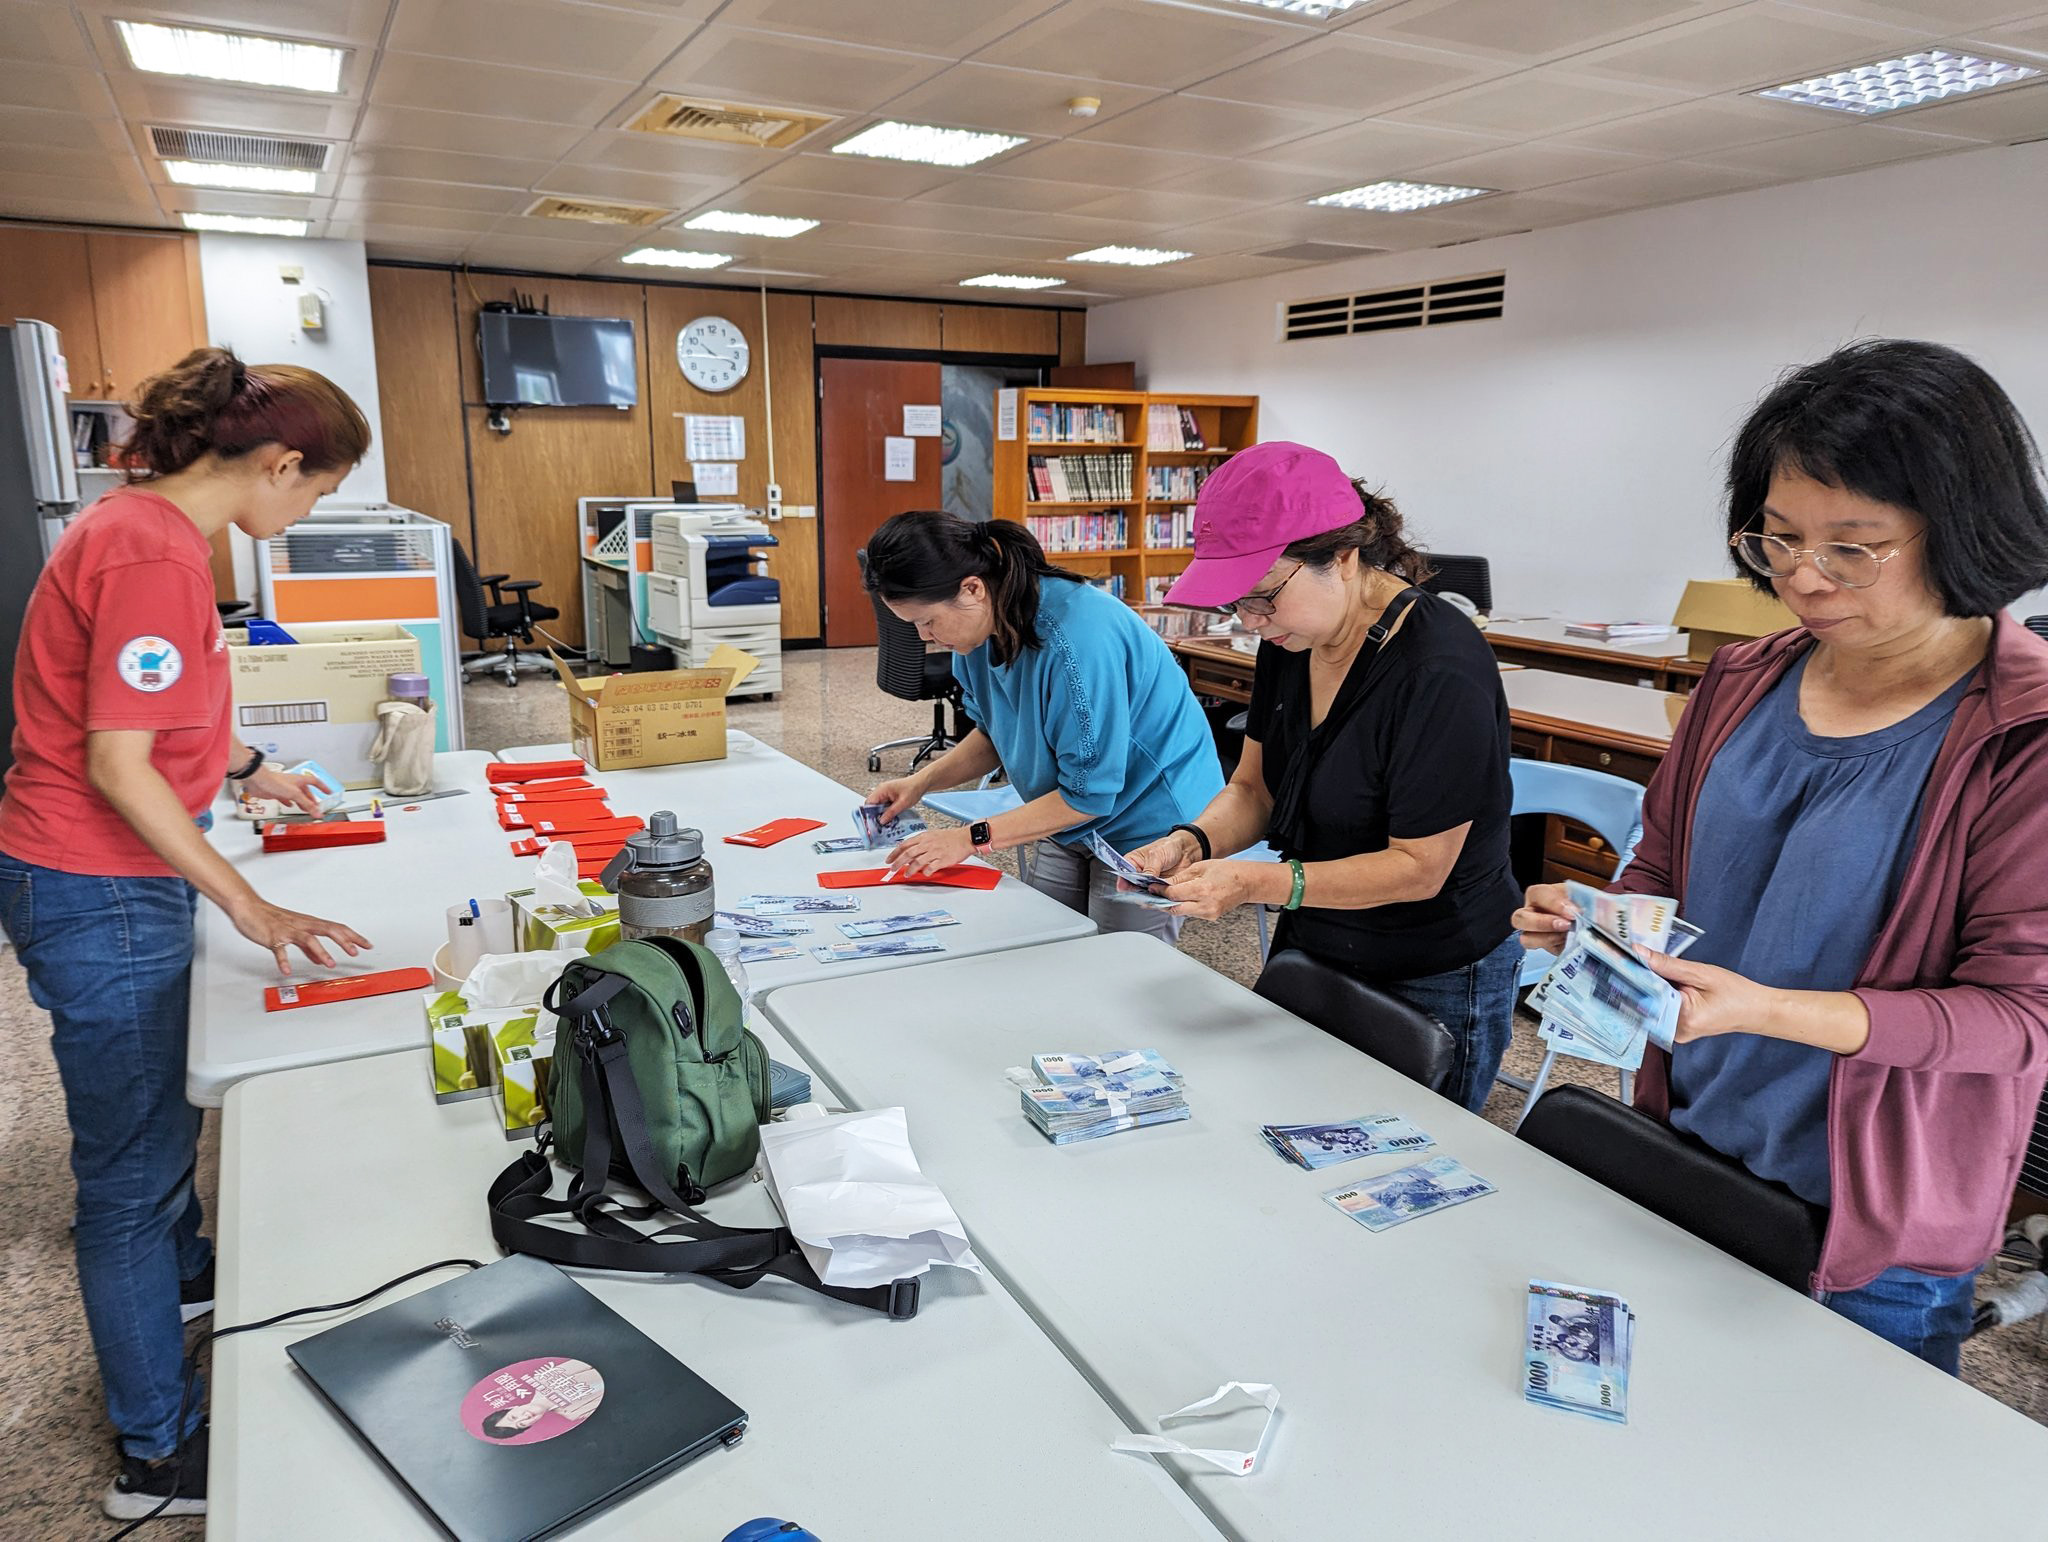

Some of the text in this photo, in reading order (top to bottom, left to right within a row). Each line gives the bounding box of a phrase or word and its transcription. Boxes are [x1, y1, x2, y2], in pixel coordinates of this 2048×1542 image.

[696, 328, 705, 336] 11
[707, 325, 717, 334] 12
[689, 337, 699, 346] 10
[734, 351, 740, 360] 3
[690, 362, 697, 371] 8
[700, 371, 706, 380] 7
[711, 375, 718, 384] 6
[723, 372, 729, 381] 5
[612, 703, 630, 714] 2024
[1375, 1116, 1401, 1124] 1000
[1388, 1135, 1425, 1147] 1000
[1335, 1190, 1358, 1201] 1000
[533, 1361, 593, 1401] 楊華美
[1528, 1360, 1549, 1393] 1000
[494, 1372, 523, 1392] 再現
[483, 1390, 510, 1408] 美力
[1600, 1384, 1612, 1407] 1000
